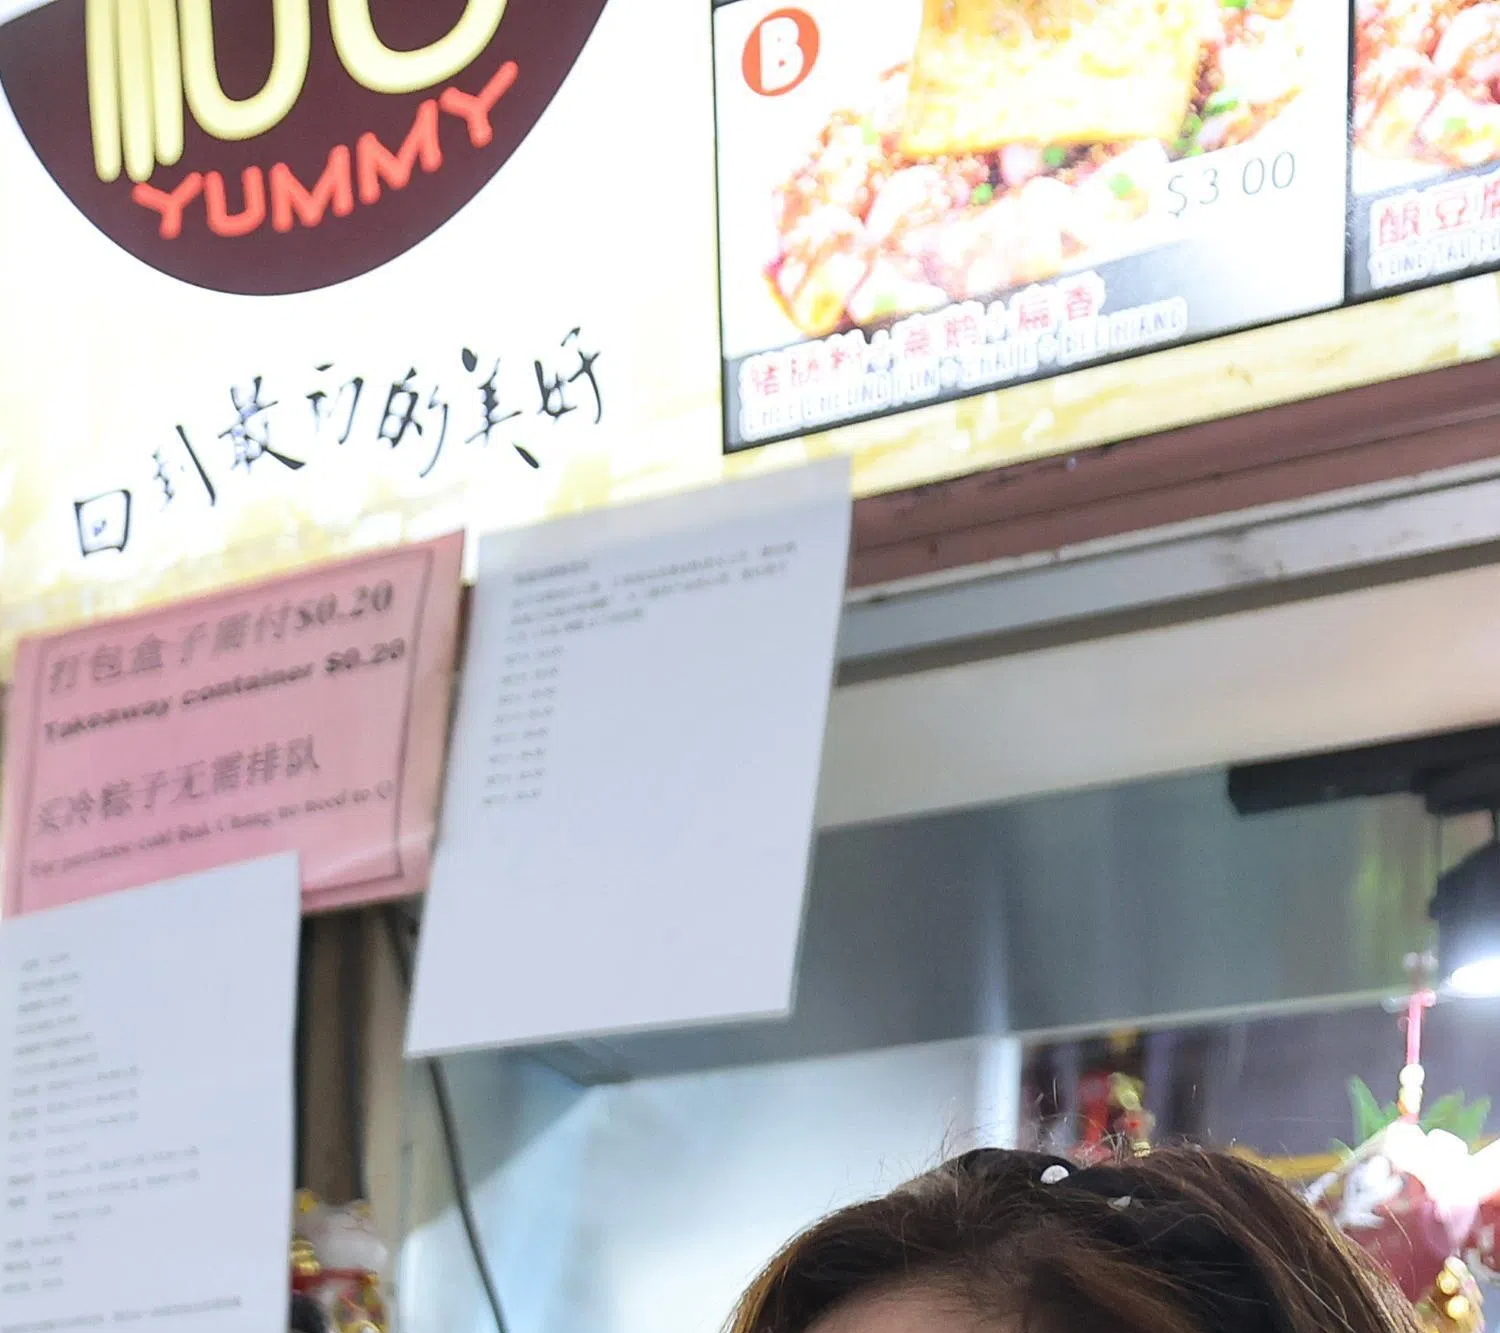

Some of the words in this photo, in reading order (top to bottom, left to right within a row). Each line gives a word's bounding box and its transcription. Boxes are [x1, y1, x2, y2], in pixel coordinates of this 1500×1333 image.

[130, 60, 520, 240] YUMMY
[42, 696, 173, 745] Takeaway
[323, 637, 407, 677] $0.20
